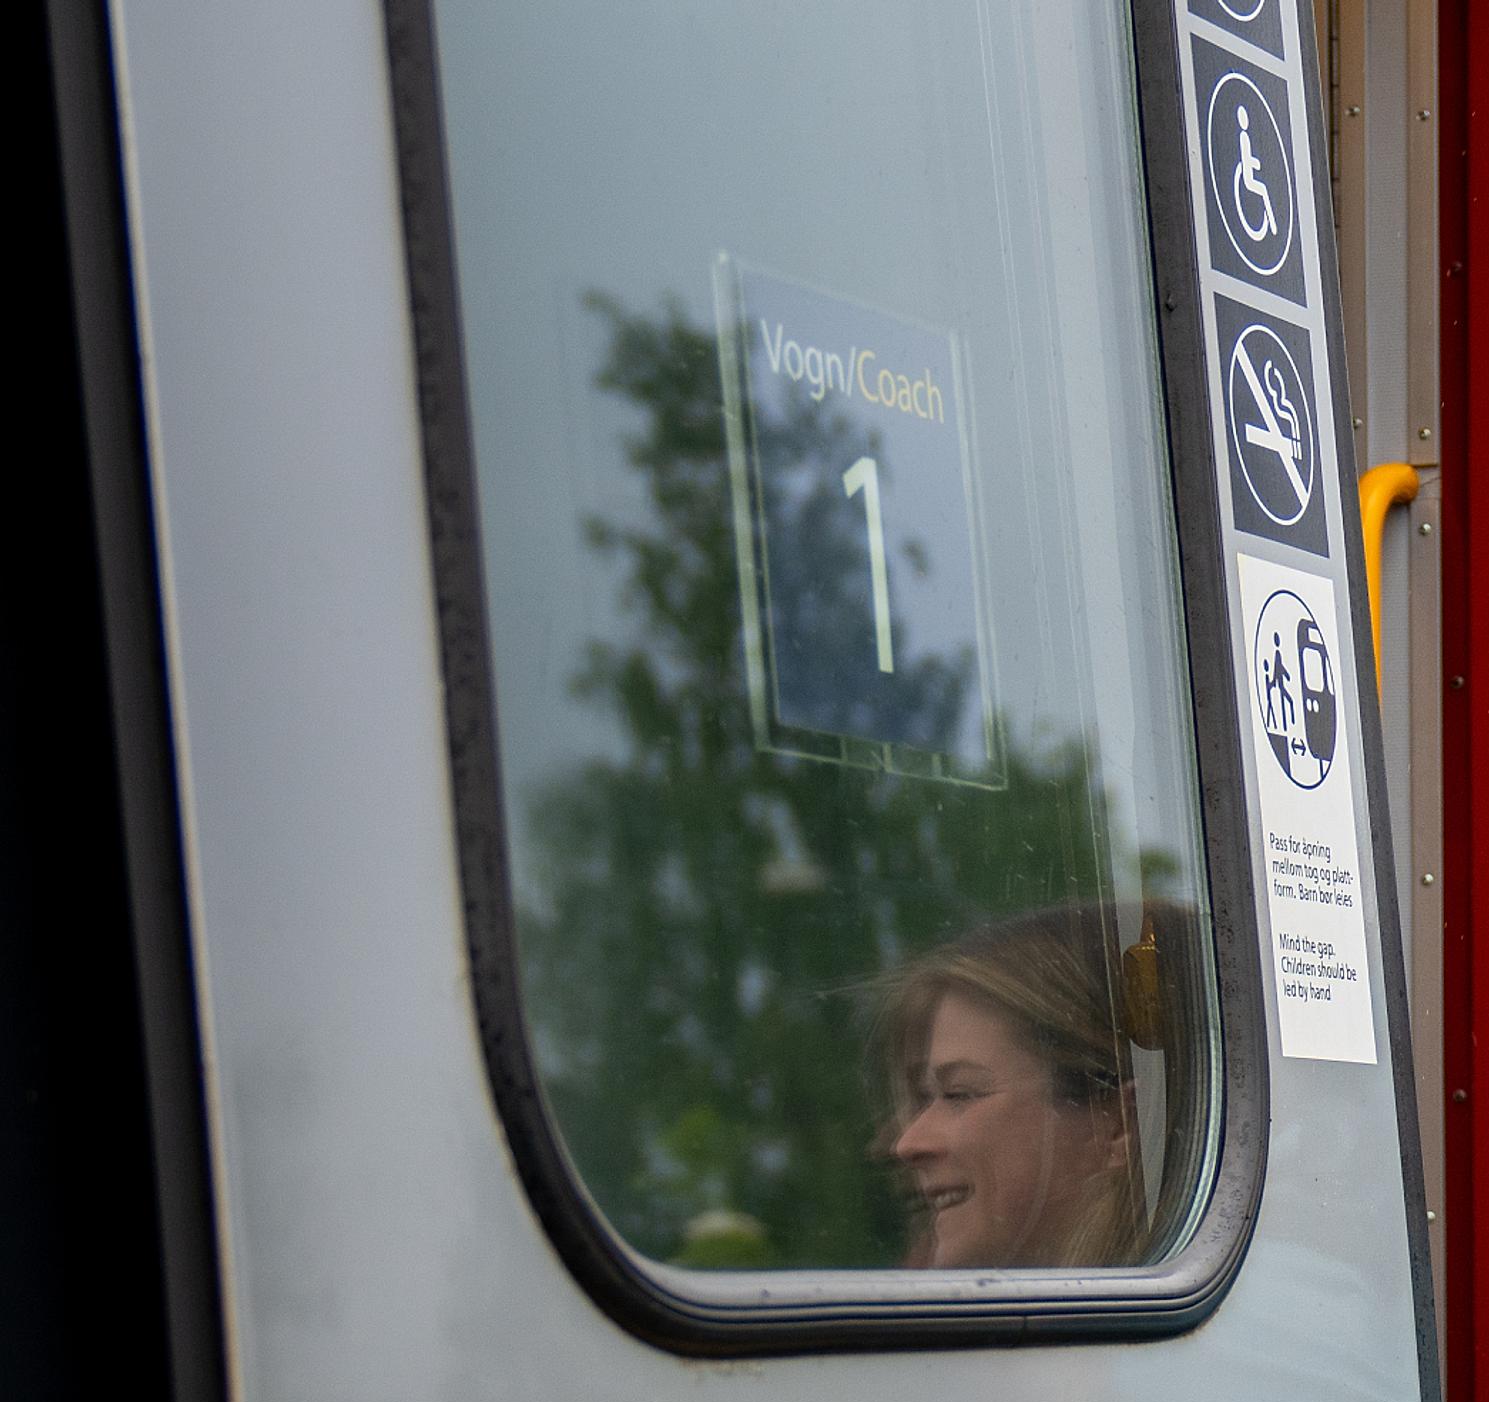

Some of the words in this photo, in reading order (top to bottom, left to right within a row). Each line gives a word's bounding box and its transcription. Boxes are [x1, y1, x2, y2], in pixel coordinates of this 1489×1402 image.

[760, 316, 946, 424] Vogn/Coach
[842, 455, 894, 674] 1
[1269, 832, 1288, 852] Pass
[1289, 835, 1301, 854] for
[1272, 858, 1303, 877] mellom
[1304, 864, 1319, 884] tog
[1320, 867, 1331, 886] og
[1273, 879, 1297, 899] form.
[1298, 883, 1318, 902] Barn
[1333, 888, 1353, 907] leies
[1279, 933, 1301, 952] Mind
[1302, 936, 1316, 954] the
[1317, 941, 1336, 959] gap.
[1281, 956, 1316, 976] Children
[1317, 961, 1345, 980] should
[1345, 963, 1357, 982] be
[1282, 978, 1297, 997] led
[1297, 980, 1308, 1003] by
[1309, 982, 1331, 1001] hand
